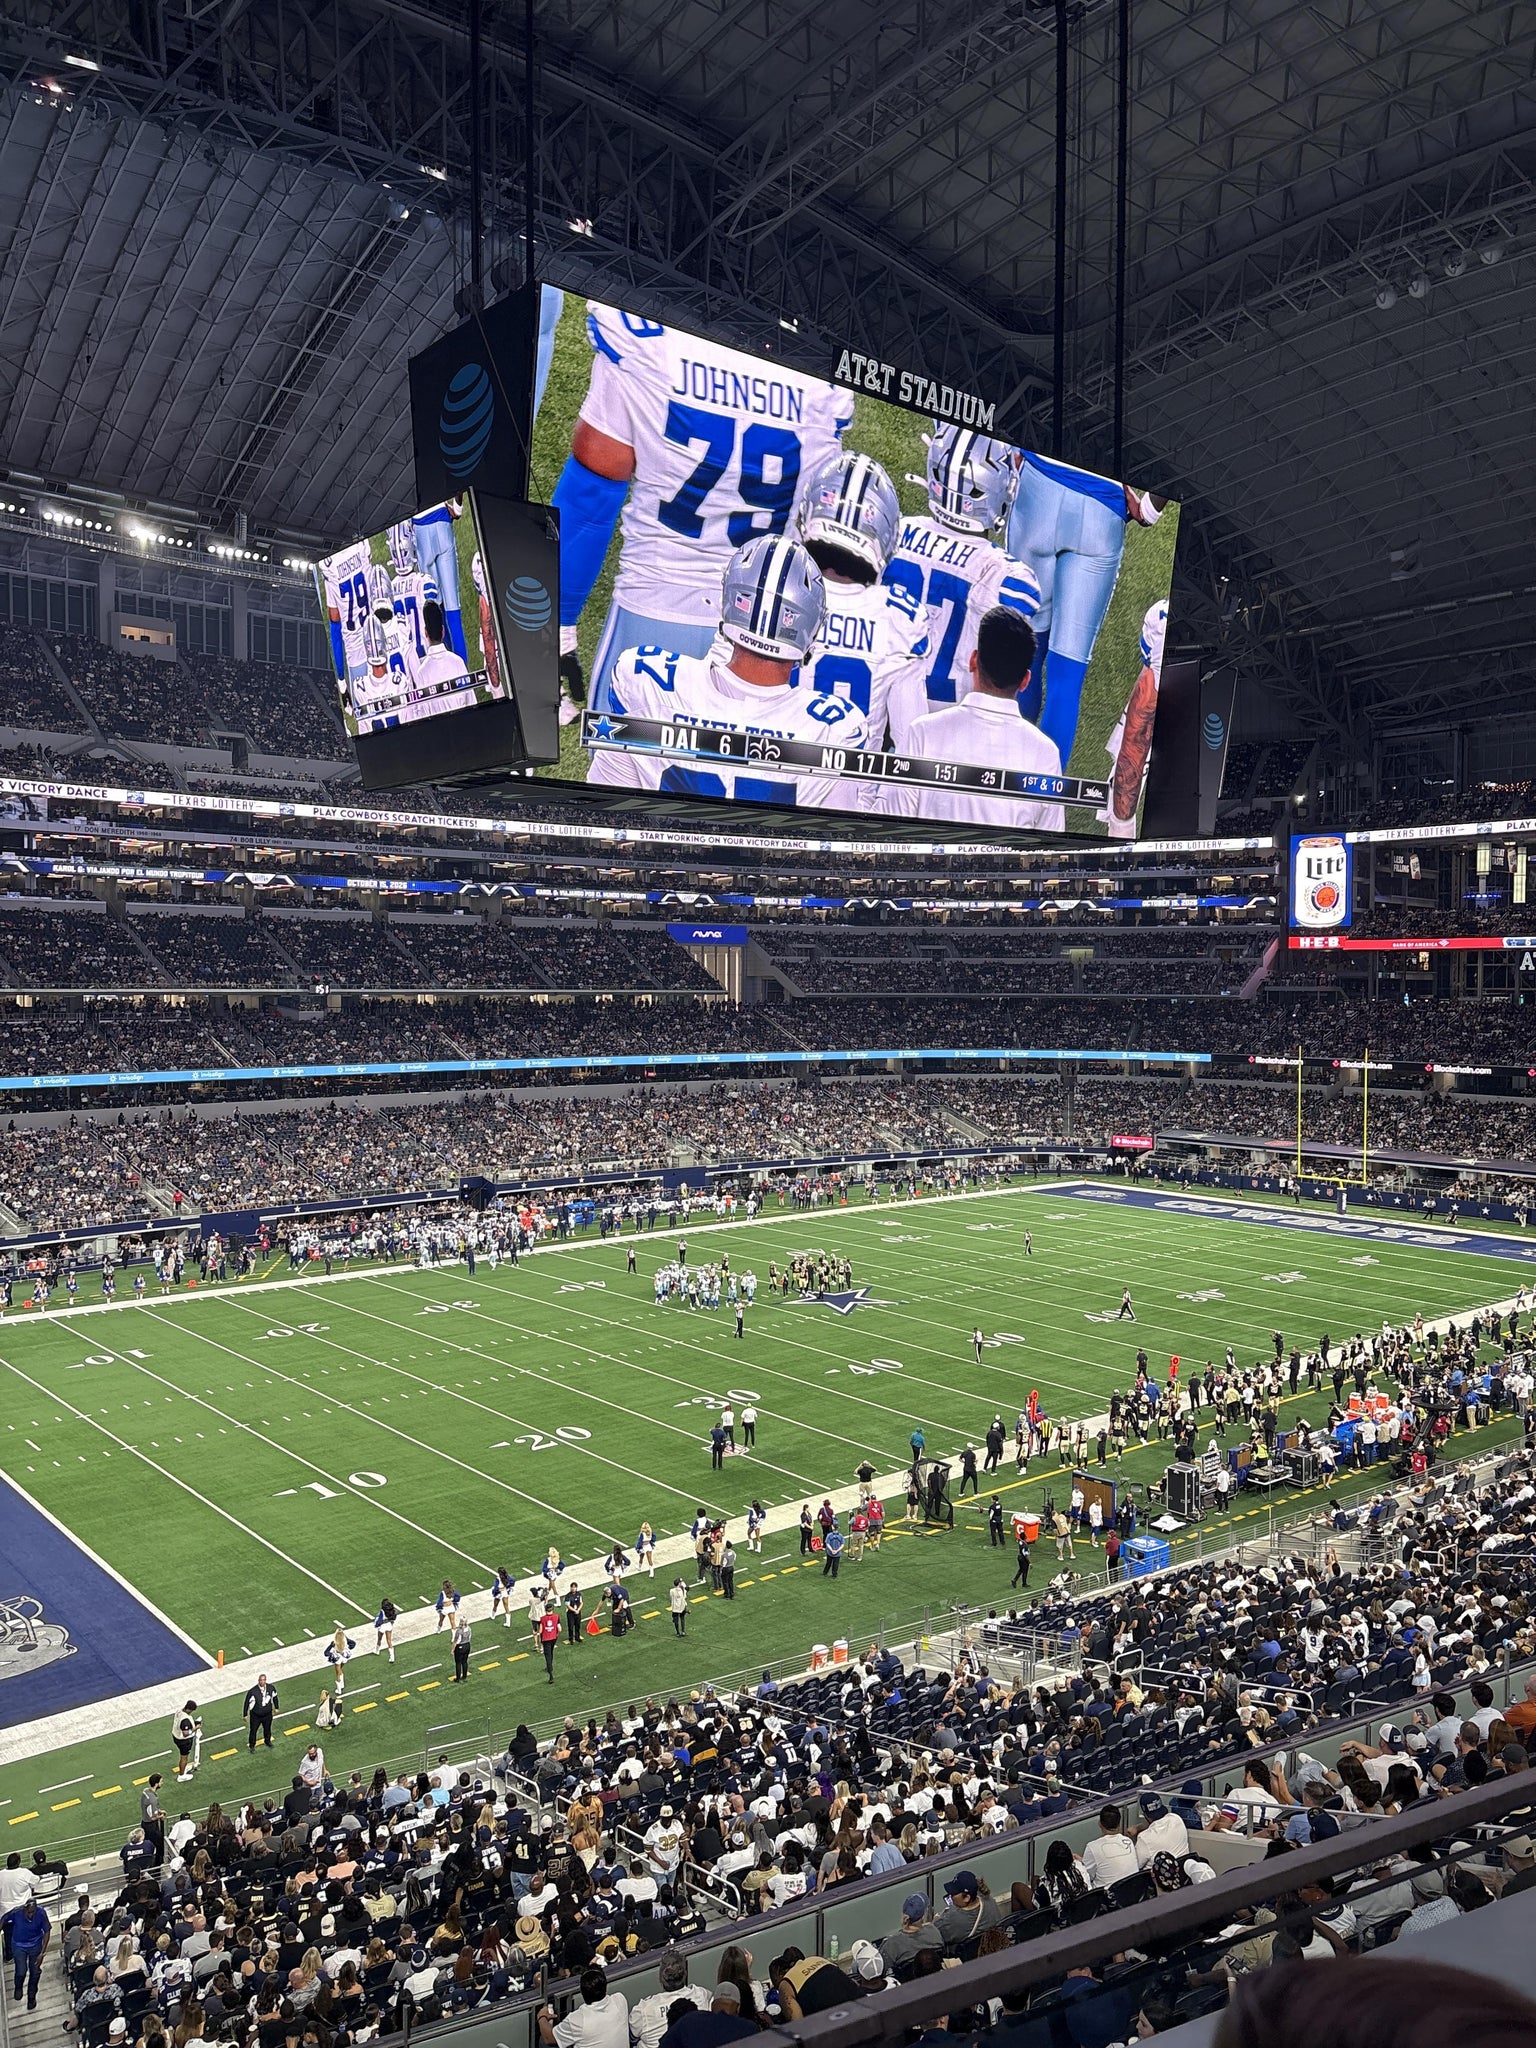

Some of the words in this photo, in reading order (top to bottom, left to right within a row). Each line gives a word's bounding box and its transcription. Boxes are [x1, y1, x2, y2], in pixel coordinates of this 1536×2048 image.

[672, 358, 804, 423] JOHNSON
[835, 350, 895, 395] AT&T
[899, 371, 996, 431] STADIUM
[657, 400, 801, 547] 79
[899, 524, 977, 568] MAFAH
[339, 571, 370, 631] 79
[739, 633, 781, 654] COWBOYS
[661, 727, 699, 751] DAL
[719, 735, 731, 756] 6
[822, 749, 846, 770] NO
[856, 753, 875, 774] 17
[893, 758, 910, 774] 2ND
[934, 764, 957, 782] 1:51
[981, 770, 996, 785] :25
[1022, 776, 1038, 789] 1ST
[1040, 779, 1048, 791] &
[1051, 781, 1063, 793] 10
[8, 781, 63, 796] VICTORY
[67, 787, 108, 798] DANCE
[172, 795, 206, 807] TEXAS
[212, 797, 254, 811] LOTTERY
[313, 808, 337, 818] PLAY
[340, 810, 390, 821] COWBOYS
[392, 814, 435, 825] SCRATCH
[438, 817, 478, 828] TICKETS!
[1506, 821, 1532, 830] PLAY
[101, 827, 135, 836] MEREDITH
[527, 824, 555, 834] TEXAS
[559, 826, 593, 836] LOTTERY
[1386, 829, 1415, 839] TEXAS
[1419, 826, 1456, 837] LOTTERY
[639, 832, 664, 840] START
[667, 834, 706, 843] WORKING
[708, 836, 721, 844] ON
[723, 837, 744, 846] YOUR
[746, 839, 780, 848] VICTORY
[782, 840, 808, 849] DANCE
[851, 843, 876, 851] TEXAS
[880, 843, 911, 852] LOTTERY
[1154, 842, 1183, 850] TEXAS
[1187, 841, 1222, 849] LOTTERY
[53, 864, 76, 872] KAROL
[1306, 857, 1344, 880] Lite
[347, 879, 377, 887] OCTOBER
[1520, 952, 1536, 970] A
[118, 1074, 144, 1082] invisalign
[1433, 1065, 1491, 1075] Blockchain.com
[43, 1077, 71, 1086] invisalign
[1155, 1200, 1471, 1246] COWBOYS
[848, 1358, 905, 1377] 40
[691, 1389, 762, 1410] 30
[514, 1426, 593, 1451] 20
[299, 1471, 388, 1500] 10
[1310, 1636, 1317, 1647] 9
[404, 1829, 417, 1844] 11
[658, 1834, 678, 1851] 32
[514, 1843, 530, 1860] 41
